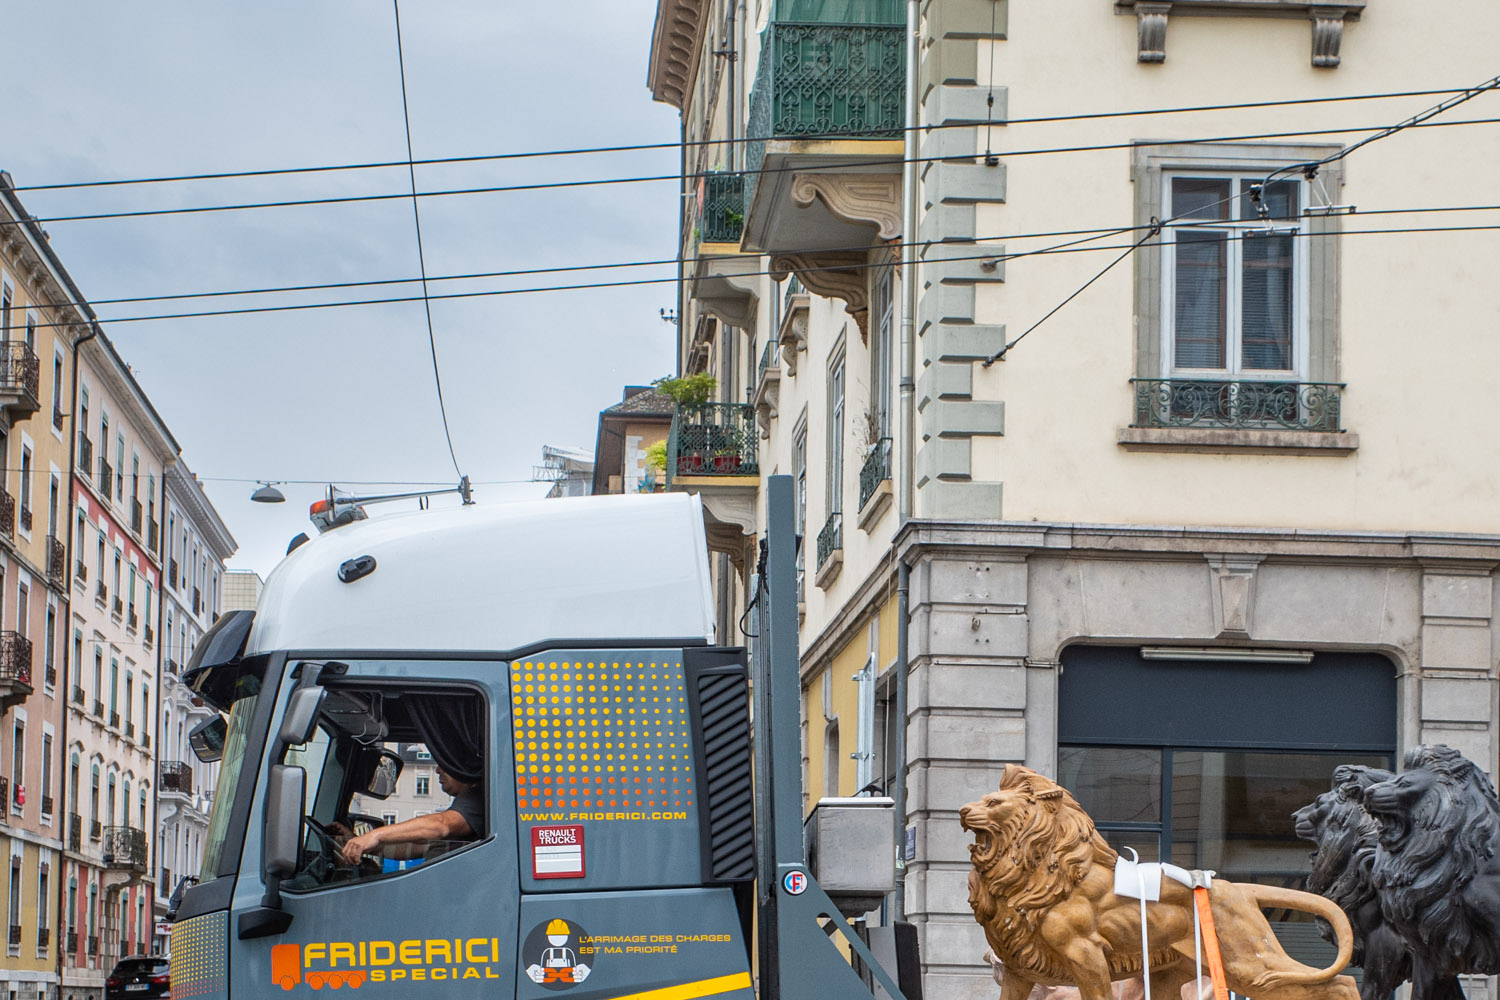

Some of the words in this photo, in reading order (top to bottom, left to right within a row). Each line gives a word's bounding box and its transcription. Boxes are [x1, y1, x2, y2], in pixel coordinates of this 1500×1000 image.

[538, 829, 576, 838] RENAULT
[539, 836, 577, 845] TRUCKS
[579, 934, 647, 943] L'ARRIMAGE
[650, 934, 673, 943] DES
[676, 934, 732, 943] CHARGES
[304, 937, 499, 968] FRIDERICI
[579, 945, 601, 954] EST
[604, 945, 623, 954] MA
[626, 944, 678, 954] PRIORITÉ
[370, 966, 499, 982] SPECIAL
